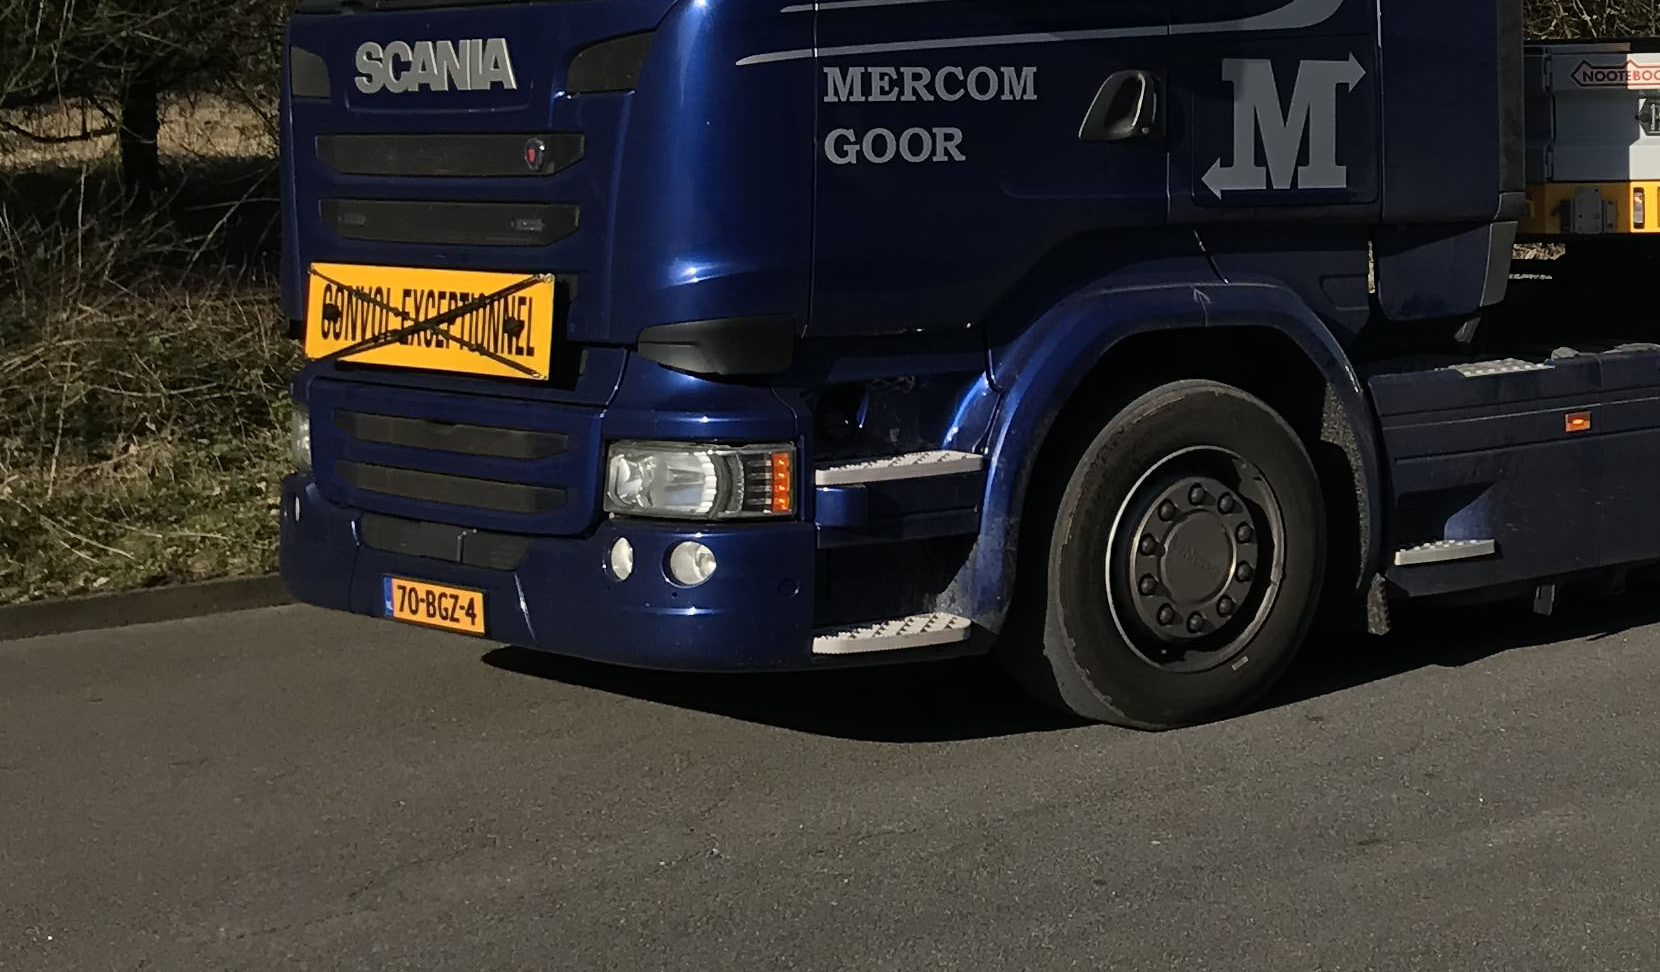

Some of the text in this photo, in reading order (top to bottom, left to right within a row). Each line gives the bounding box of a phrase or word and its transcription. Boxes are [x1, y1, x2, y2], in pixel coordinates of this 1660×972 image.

[355, 38, 517, 94] SCANIA
[823, 66, 1037, 102] MERCOM
[824, 127, 966, 164] GOOR
[397, 584, 477, 626] 70-BGZ-4
